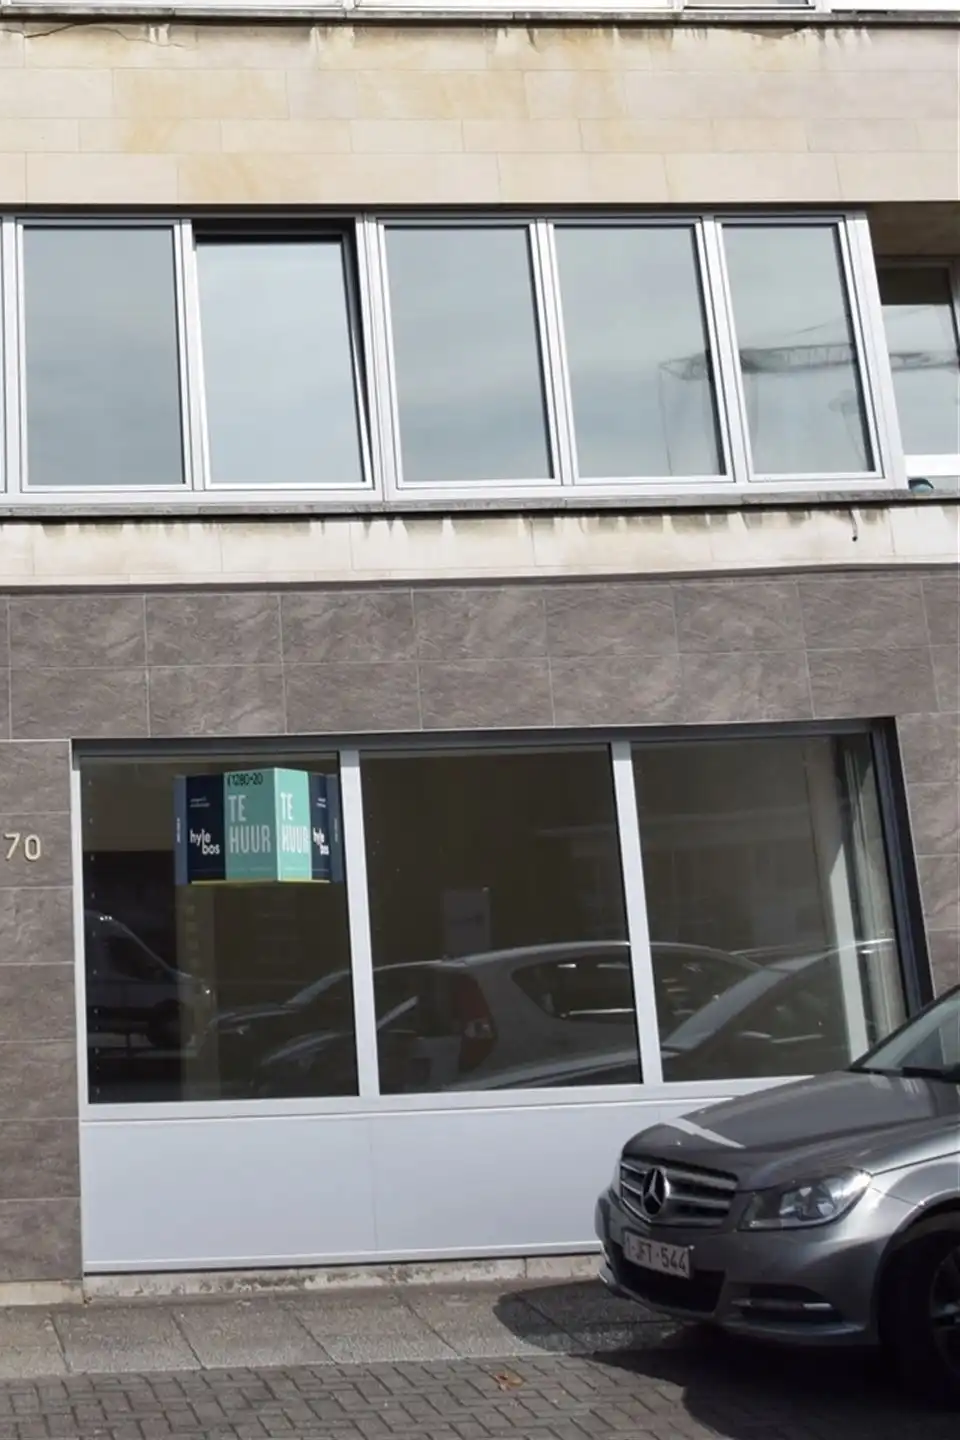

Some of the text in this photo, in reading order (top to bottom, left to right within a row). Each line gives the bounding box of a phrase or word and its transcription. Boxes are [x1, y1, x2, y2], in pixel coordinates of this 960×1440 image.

[228, 795, 247, 822] TE
[280, 792, 293, 821] TE
[4, 832, 41, 860] 70
[229, 825, 271, 854] HUUR
[282, 824, 311, 854] HUUR
